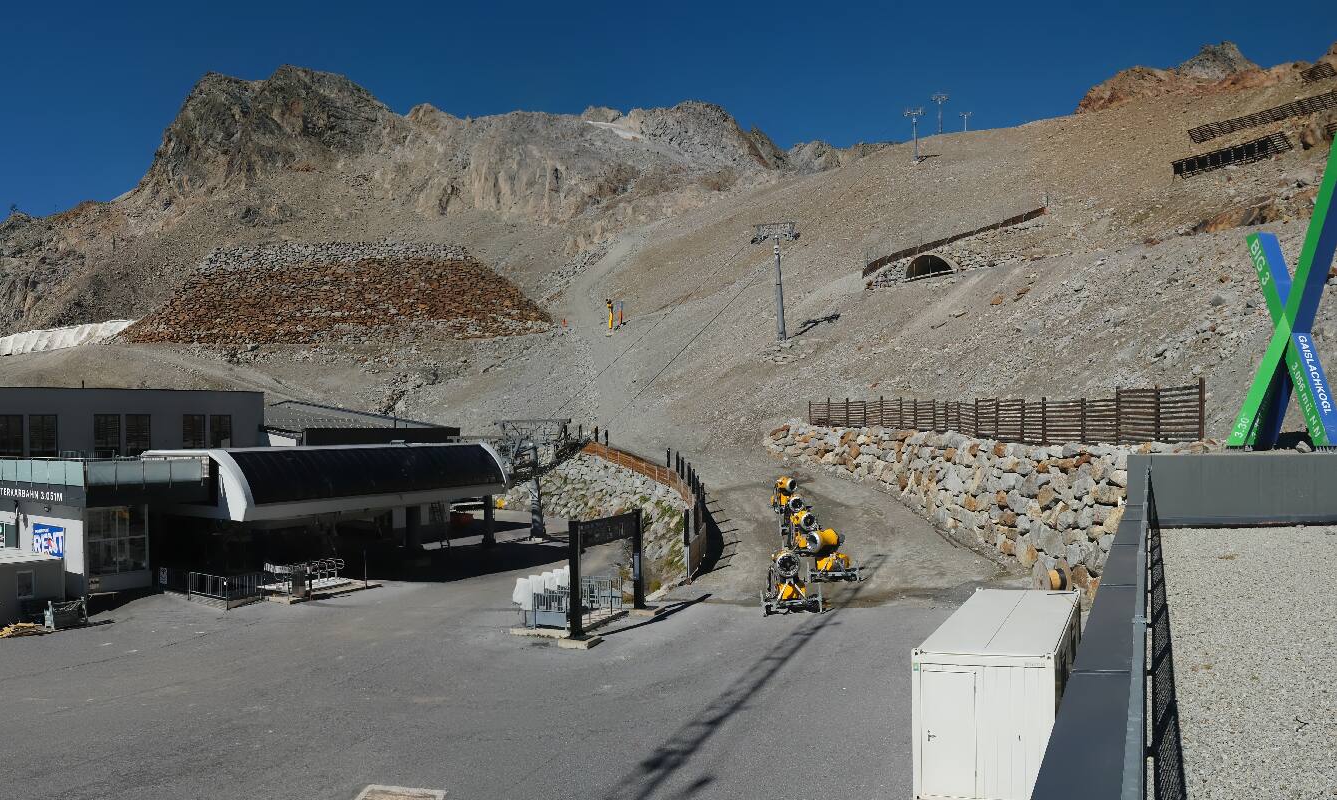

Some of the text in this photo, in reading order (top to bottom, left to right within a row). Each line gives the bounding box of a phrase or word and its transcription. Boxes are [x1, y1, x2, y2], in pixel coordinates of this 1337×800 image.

[1251, 238, 1270, 286] BIG 3
[1298, 335, 1332, 415] GAISLACHKOGL
[33, 532, 64, 554] RENT
